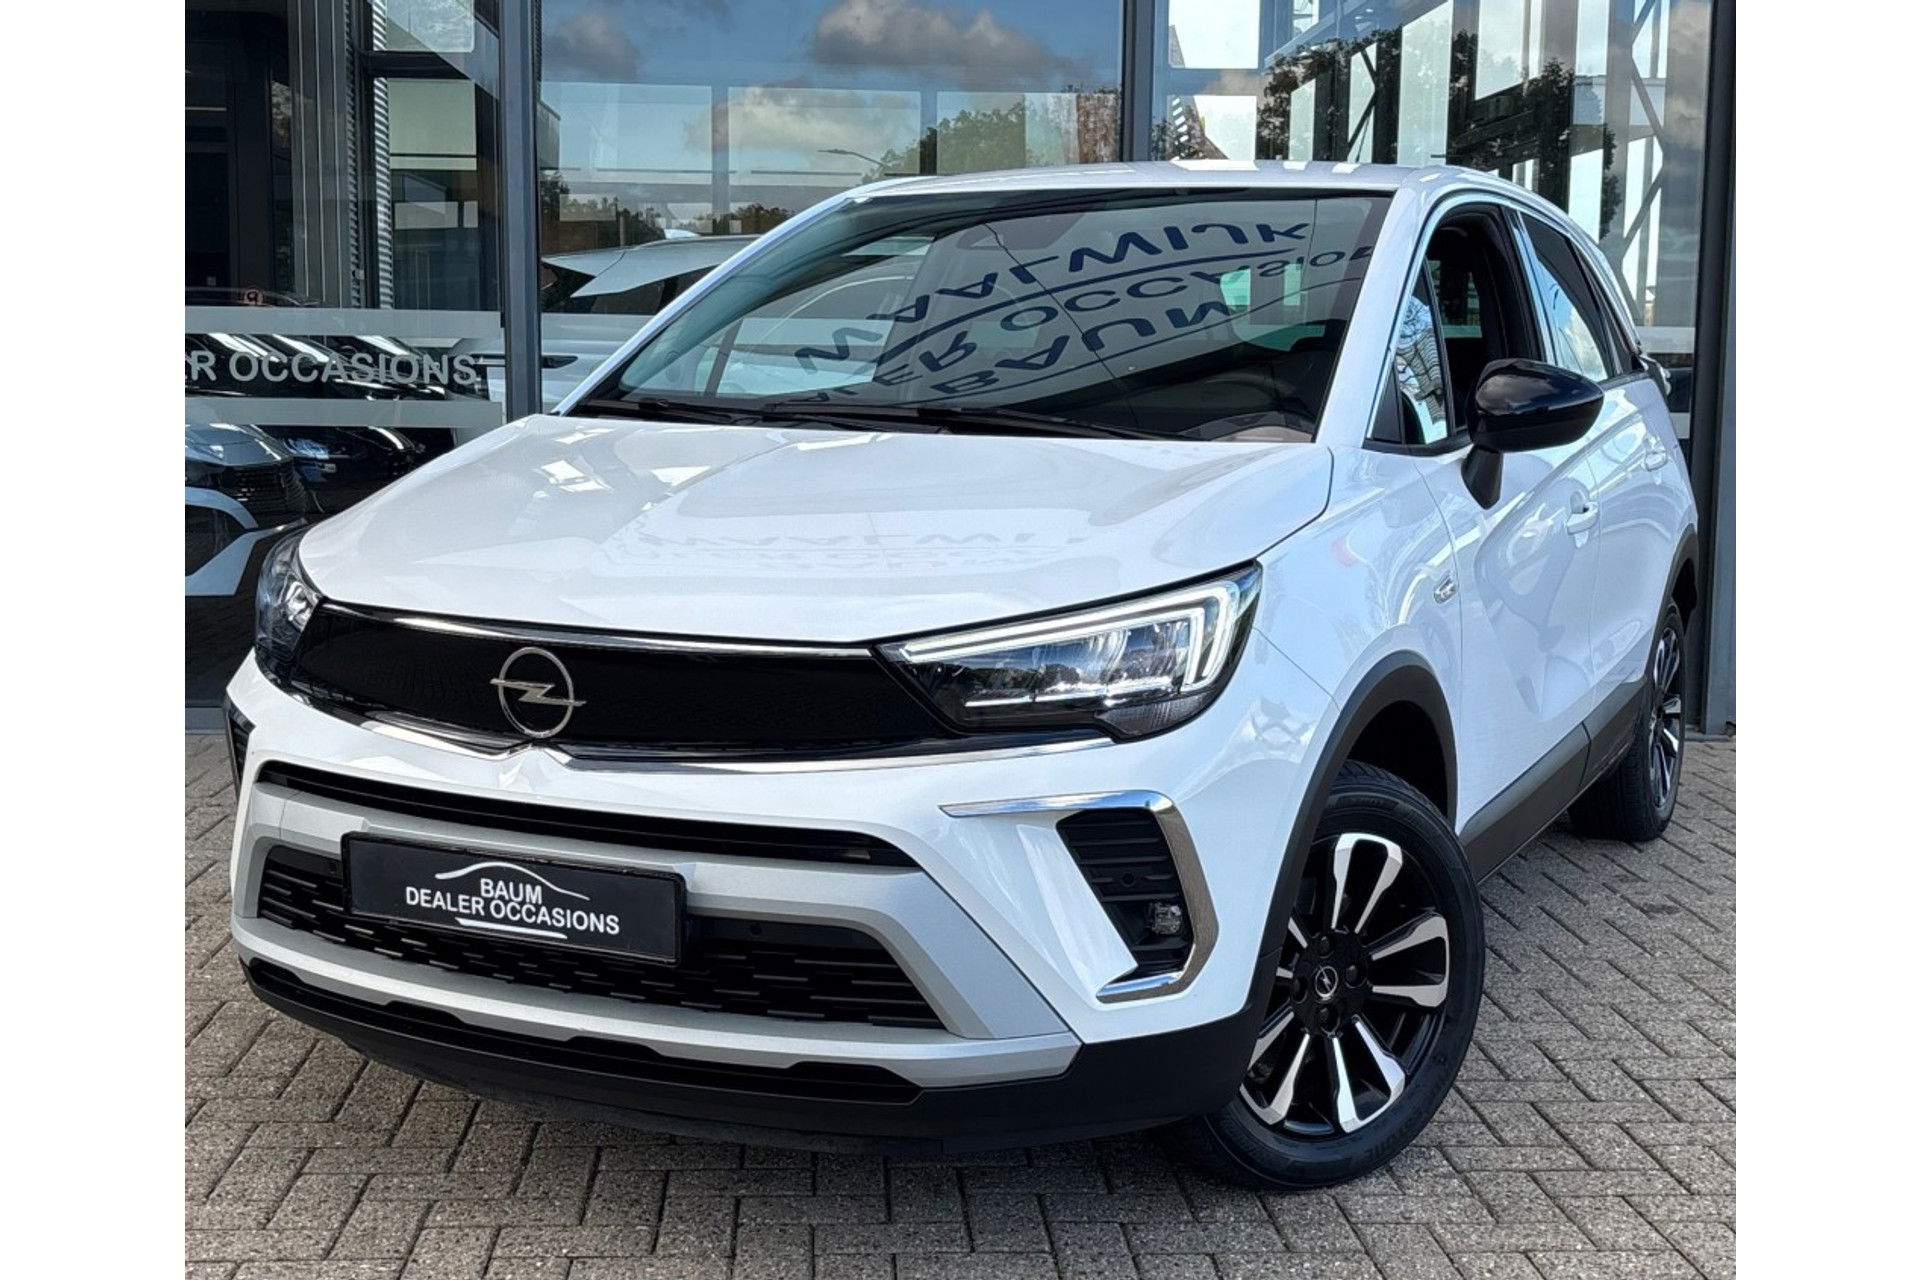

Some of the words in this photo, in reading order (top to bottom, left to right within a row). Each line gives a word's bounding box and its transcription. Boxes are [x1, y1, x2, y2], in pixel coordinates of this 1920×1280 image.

[229, 351, 477, 385] OCCASIONS
[480, 878, 542, 904] BAUM
[406, 886, 485, 916] DEALER
[490, 899, 620, 935] OCCASIONS
